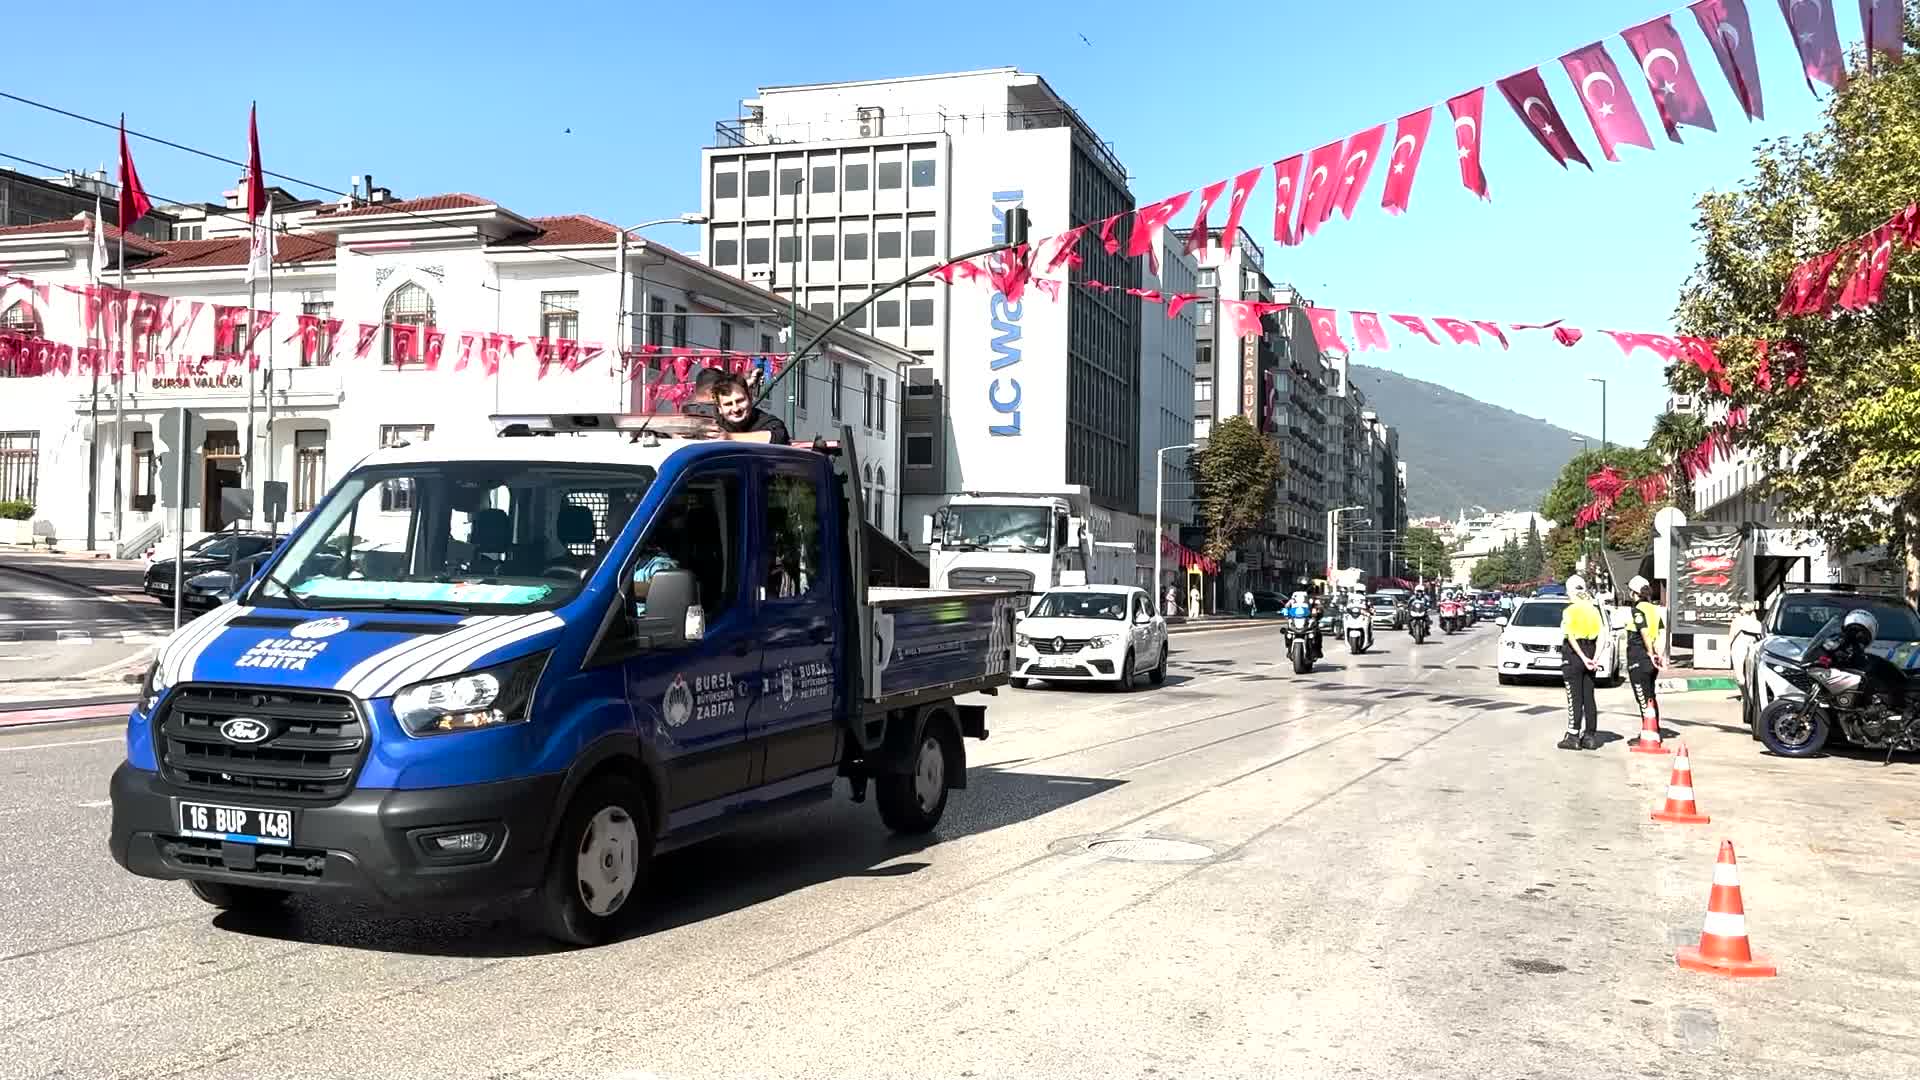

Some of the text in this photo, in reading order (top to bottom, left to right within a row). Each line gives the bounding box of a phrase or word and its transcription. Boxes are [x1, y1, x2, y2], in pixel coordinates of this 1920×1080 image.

[152, 378, 191, 389] BURSA
[989, 378, 1022, 437] LC
[255, 638, 329, 652] BURSA
[234, 655, 308, 671] ZABITA
[695, 672, 734, 692] BURSA
[696, 702, 735, 720] ZABITA
[228, 720, 260, 739] Ford
[190, 806, 288, 838] 16 BUP 148
